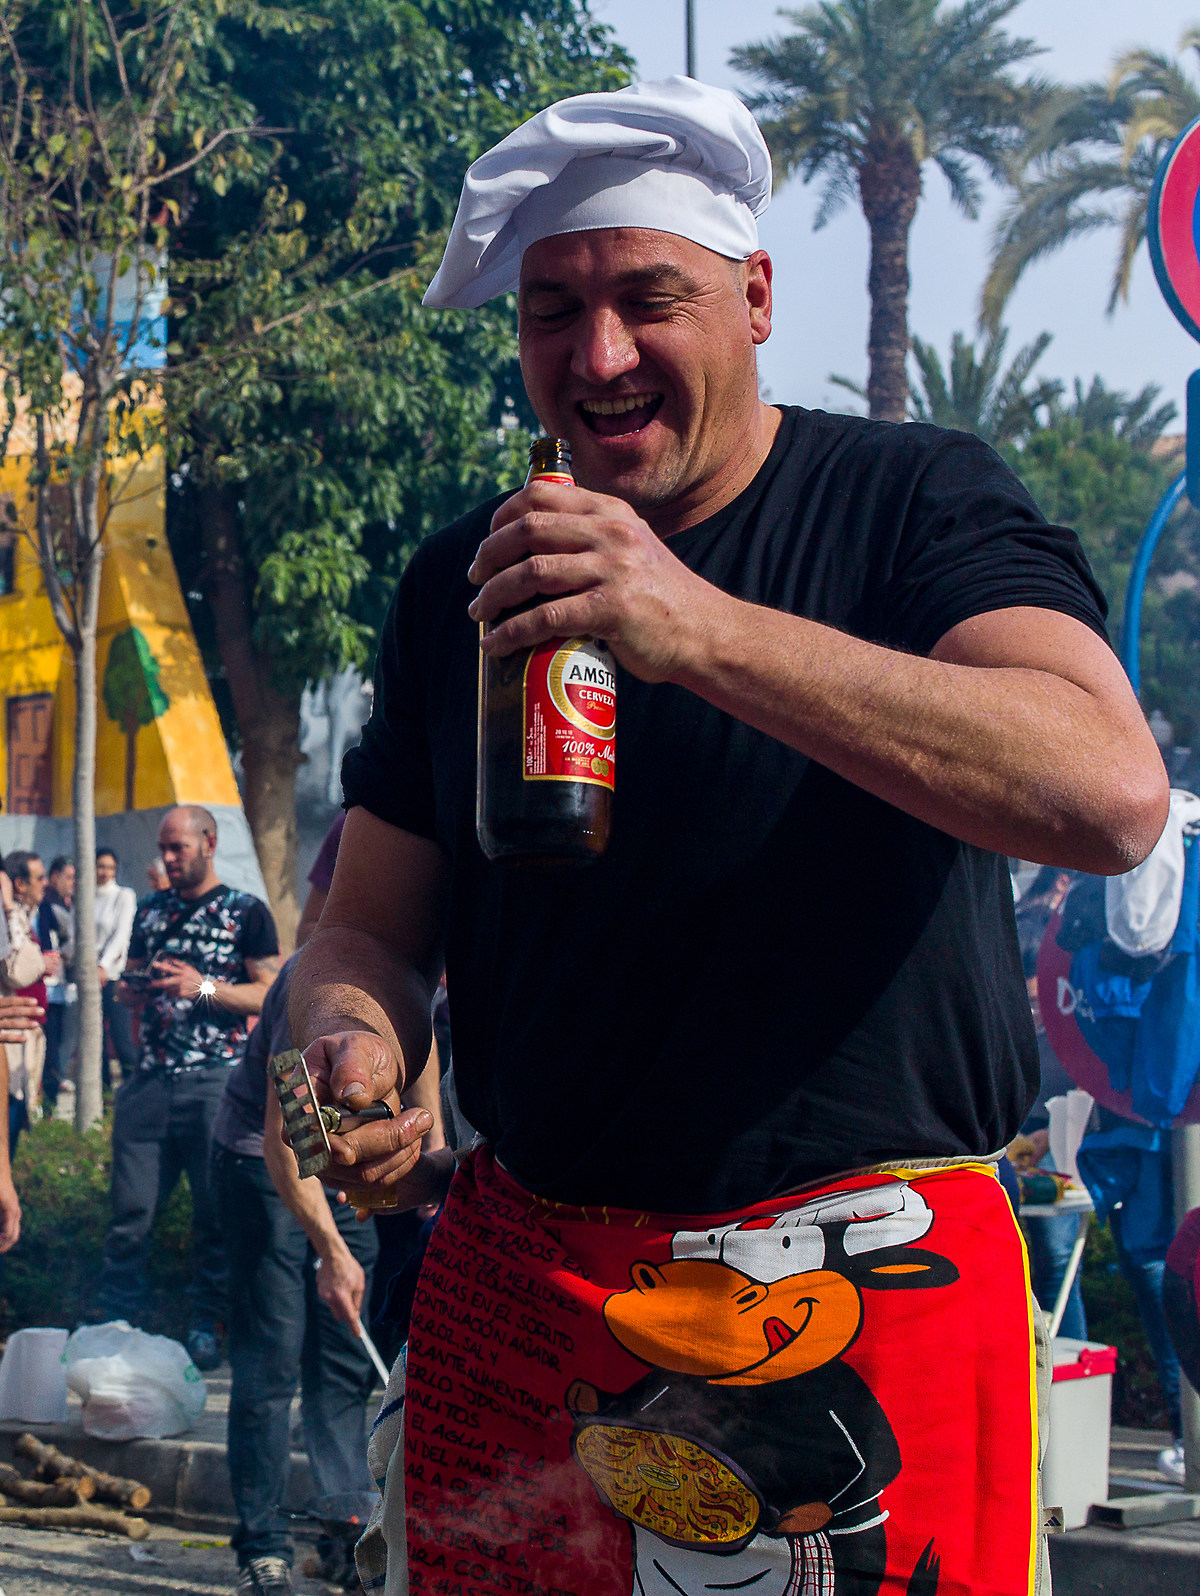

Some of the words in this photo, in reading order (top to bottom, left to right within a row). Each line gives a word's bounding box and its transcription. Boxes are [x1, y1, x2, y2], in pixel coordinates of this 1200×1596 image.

[578, 689, 614, 708] CERVEZA
[562, 740, 595, 755] 100%
[416, 1289, 507, 1346] ONTINUACIÓN
[471, 1291, 494, 1314] EN
[494, 1303, 511, 1325] EL
[463, 1336, 484, 1361] SAL
[490, 1350, 499, 1367] Y
[406, 1361, 454, 1392] ERLO
[411, 1412, 428, 1434] EL
[431, 1423, 488, 1455] AGUA
[405, 1461, 426, 1484] AR
[430, 1471, 442, 1489] A
[421, 1440, 449, 1466] DEL
[456, 1456, 542, 1498] MARISCO
[412, 1490, 430, 1513] EL
[436, 1500, 522, 1543] MARISCO
[527, 1527, 573, 1559] POR
[407, 1541, 447, 1571] URA
[516, 1553, 529, 1574] A
